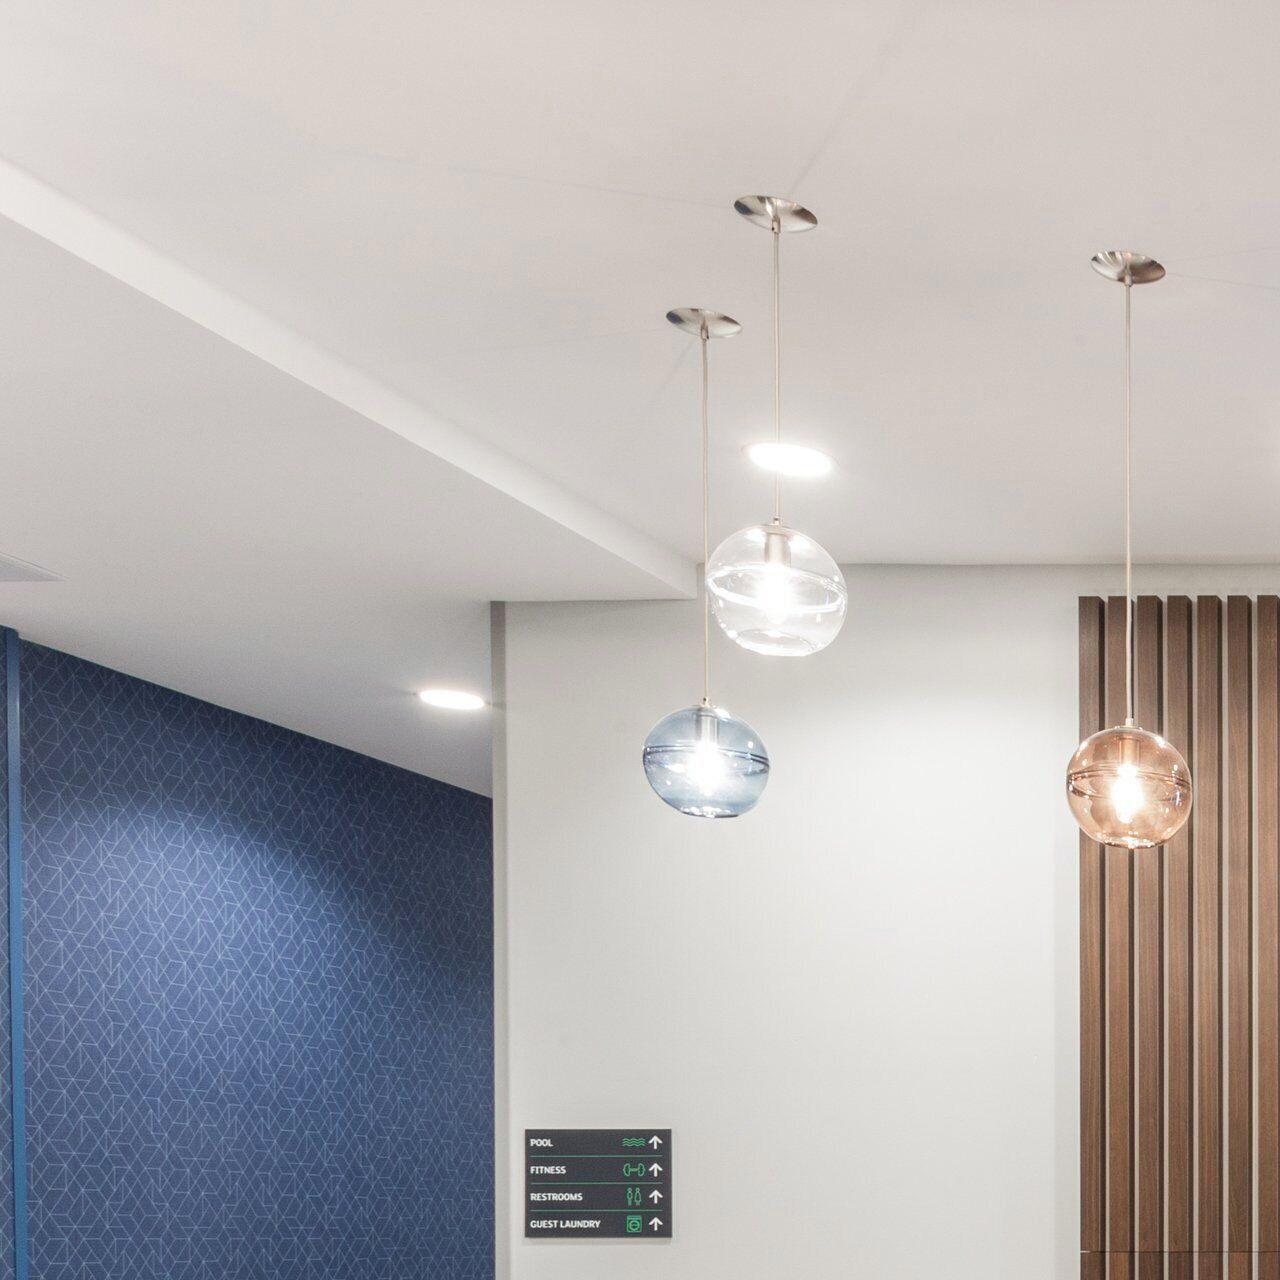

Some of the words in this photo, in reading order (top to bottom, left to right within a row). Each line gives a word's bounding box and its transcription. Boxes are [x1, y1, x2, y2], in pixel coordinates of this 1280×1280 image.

[530, 1139, 553, 1147] POOL
[530, 1166, 566, 1174] FITNESS
[530, 1193, 583, 1201] RESTROOMS
[530, 1220, 558, 1228] GUEST
[560, 1220, 600, 1228] LAUNDRY
